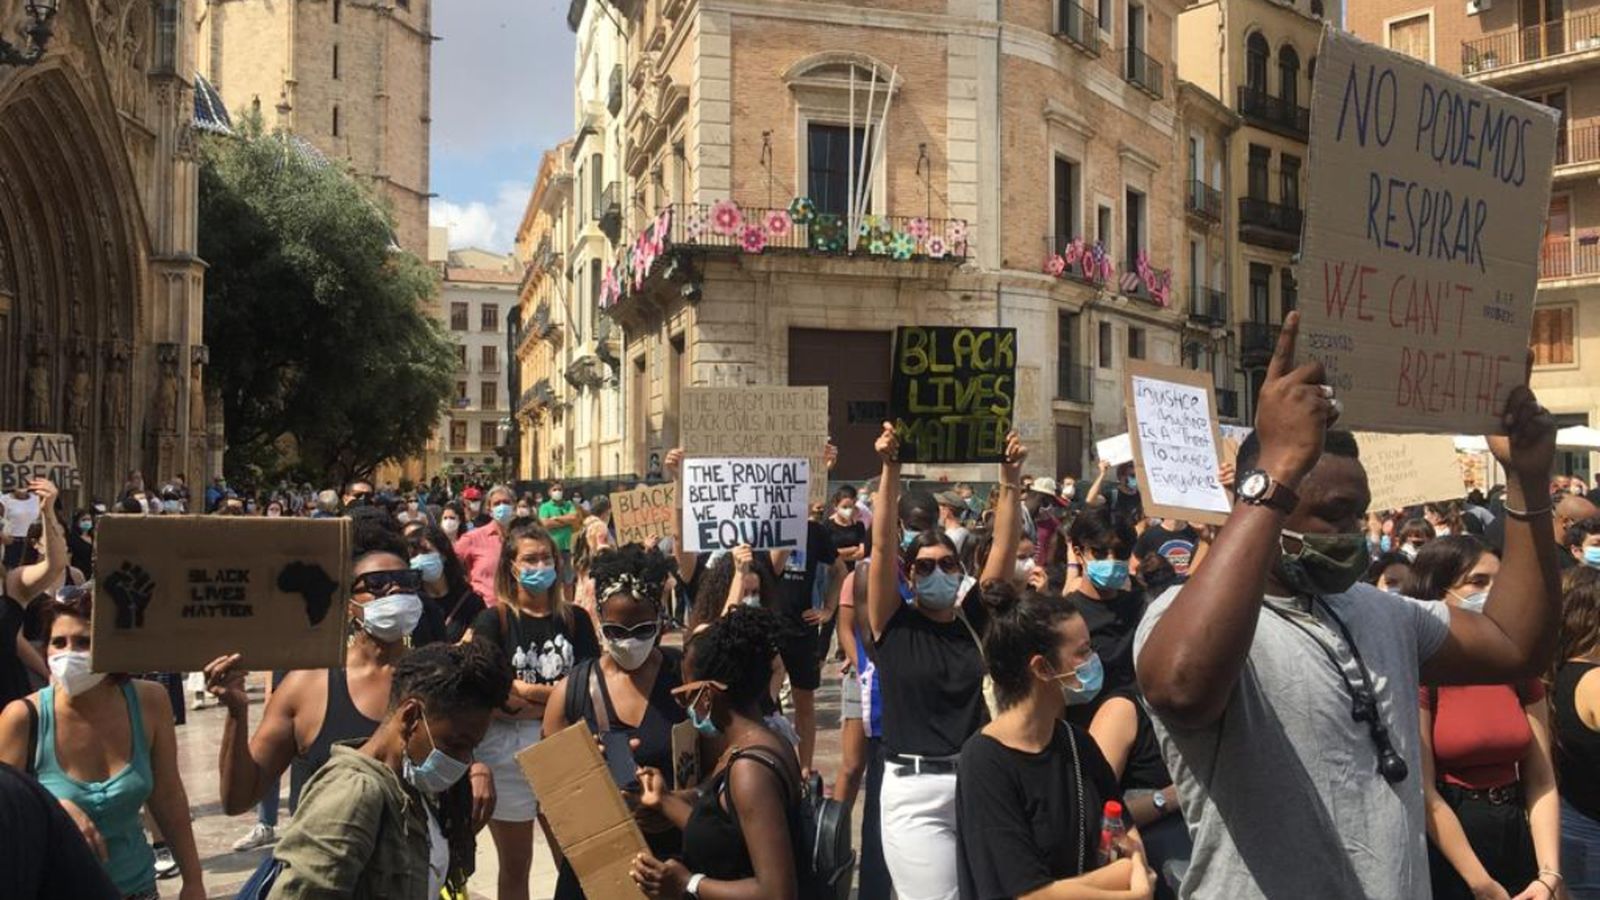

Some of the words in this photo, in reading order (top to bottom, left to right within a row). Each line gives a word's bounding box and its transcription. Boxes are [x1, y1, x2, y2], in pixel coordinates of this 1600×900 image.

[1336, 63, 1398, 147] NO
[1416, 83, 1532, 187] PODEMOS
[1367, 172, 1488, 274] RESPIRAR
[1324, 261, 1378, 321] WE
[1388, 274, 1474, 338] CAN'T
[901, 327, 1014, 375] BLACK
[1397, 346, 1511, 418] BREATHE
[683, 391, 713, 411] THE
[718, 390, 764, 411] RACISM
[768, 391, 800, 410] THAT
[908, 373, 1012, 416] LIVES
[682, 413, 722, 431] BLACK
[765, 411, 775, 431] IN
[779, 413, 802, 431] THE
[685, 431, 699, 452] IS
[703, 434, 729, 453] THE
[733, 434, 767, 453] SAME
[895, 414, 1011, 462] MATTER
[1160, 425, 1171, 441] A
[1151, 442, 1168, 461] To
[688, 464, 724, 483] THE
[618, 487, 674, 514] BLACK
[689, 484, 741, 503] BELIEF
[751, 485, 797, 503] THAT
[619, 507, 672, 528] LIVES
[691, 504, 717, 521] WE
[732, 504, 760, 519] ARE
[769, 504, 798, 519] ALL
[698, 519, 798, 549] EQUAL
[188, 568, 250, 583] BLACK
[191, 585, 246, 601] LIVES
[182, 603, 254, 618] MATTER
